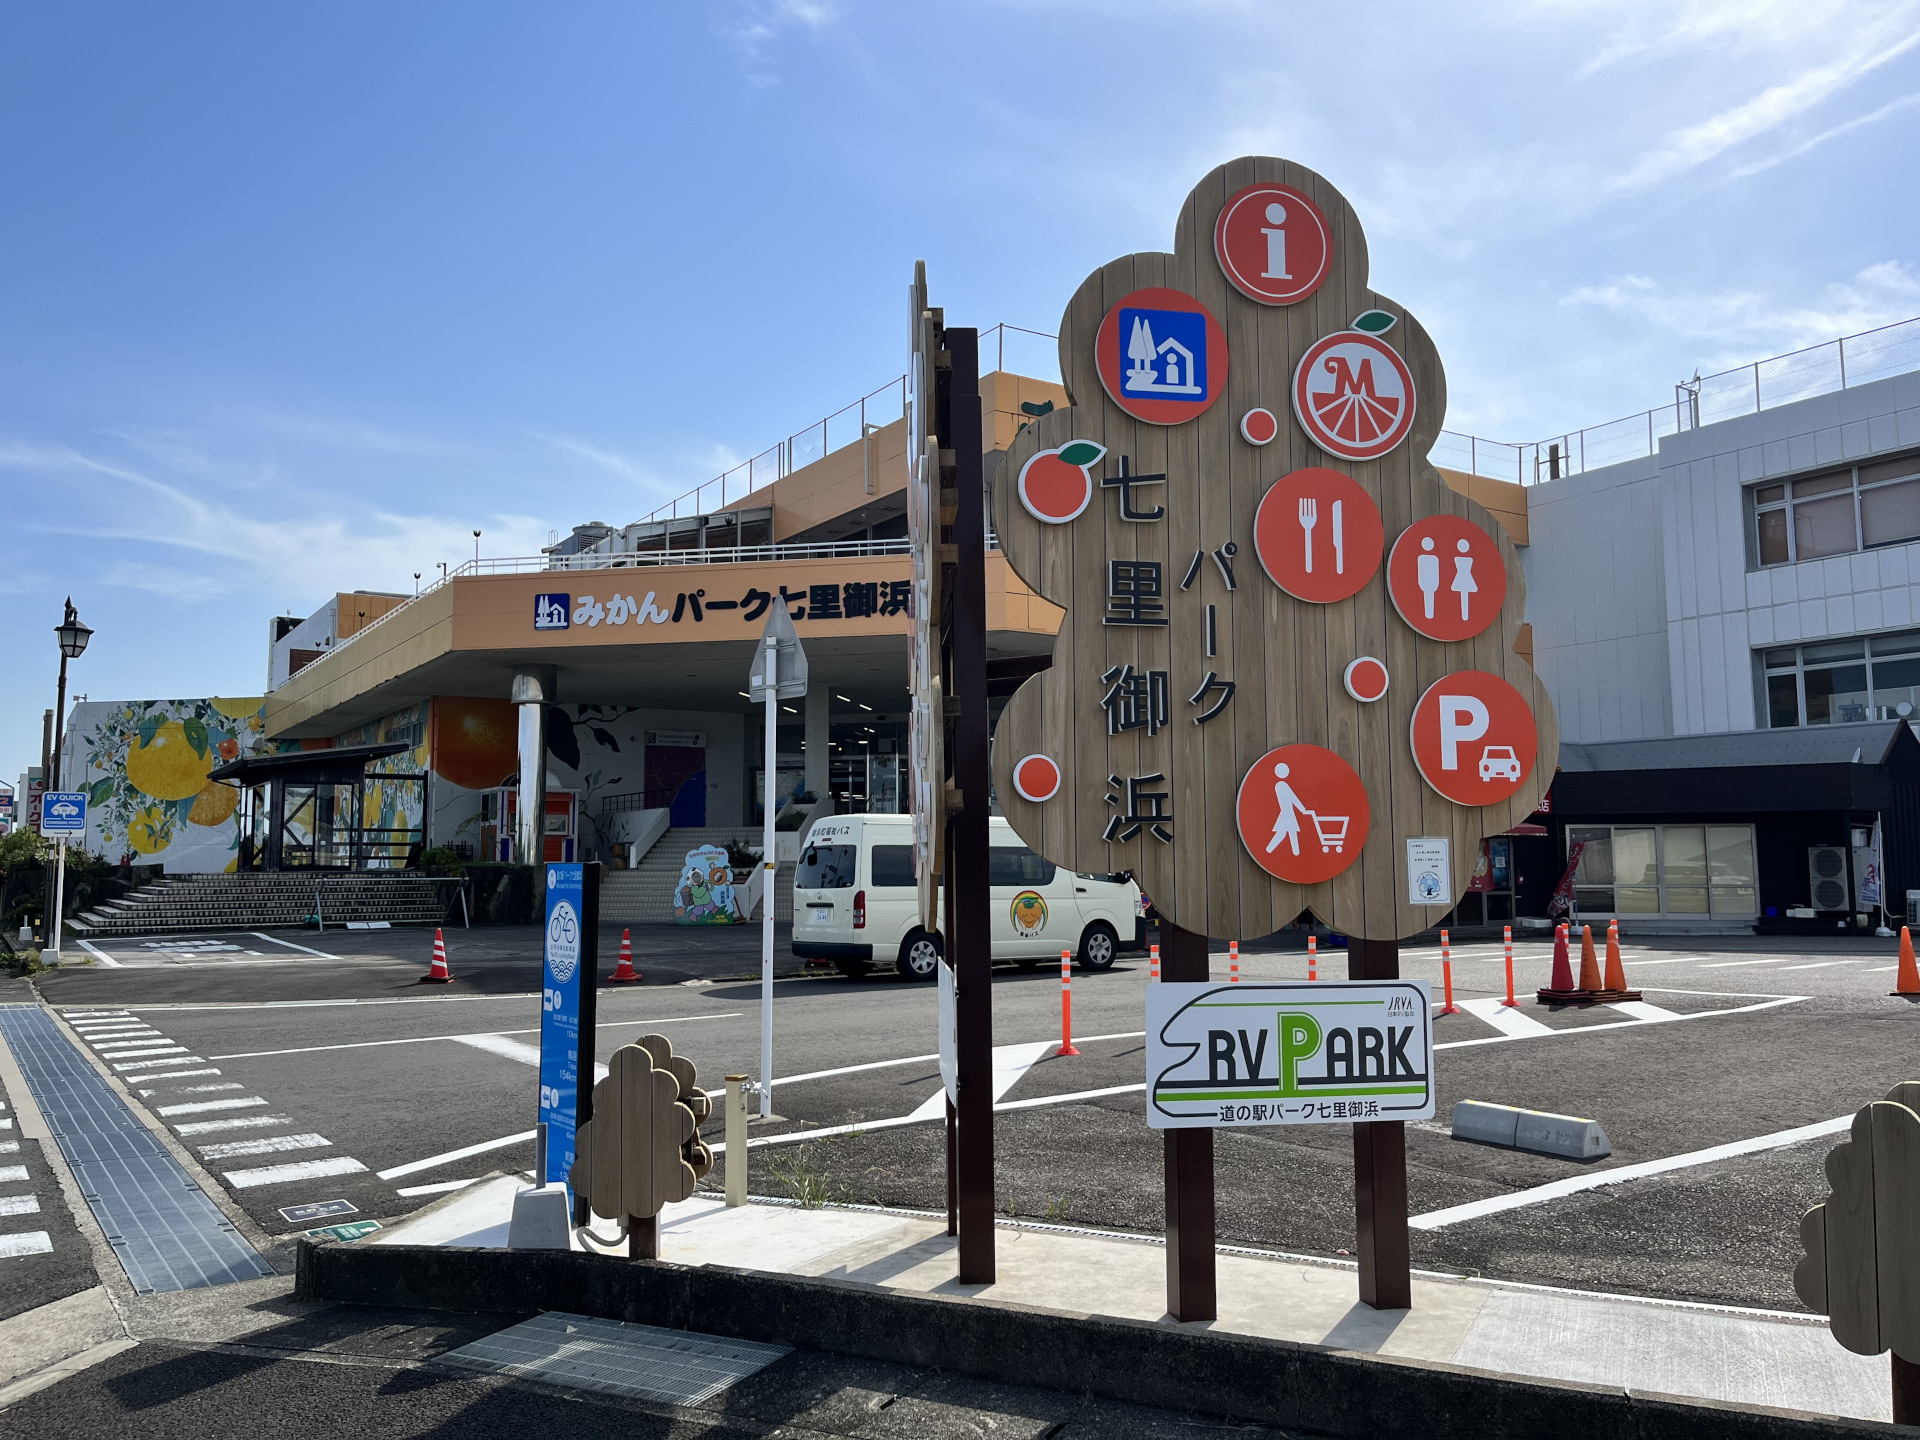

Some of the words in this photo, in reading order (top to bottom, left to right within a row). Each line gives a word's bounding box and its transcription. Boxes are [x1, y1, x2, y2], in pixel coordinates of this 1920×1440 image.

[572, 580, 911, 627] みかんパーク七里御浜
[1180, 541, 1238, 725] パーク
[1100, 455, 1173, 844] 七里御浜
[1439, 695, 1490, 770] P
[560, 1070, 576, 1082] 154km
[1219, 1101, 1380, 1122] 道の駅パーク七里御浜
